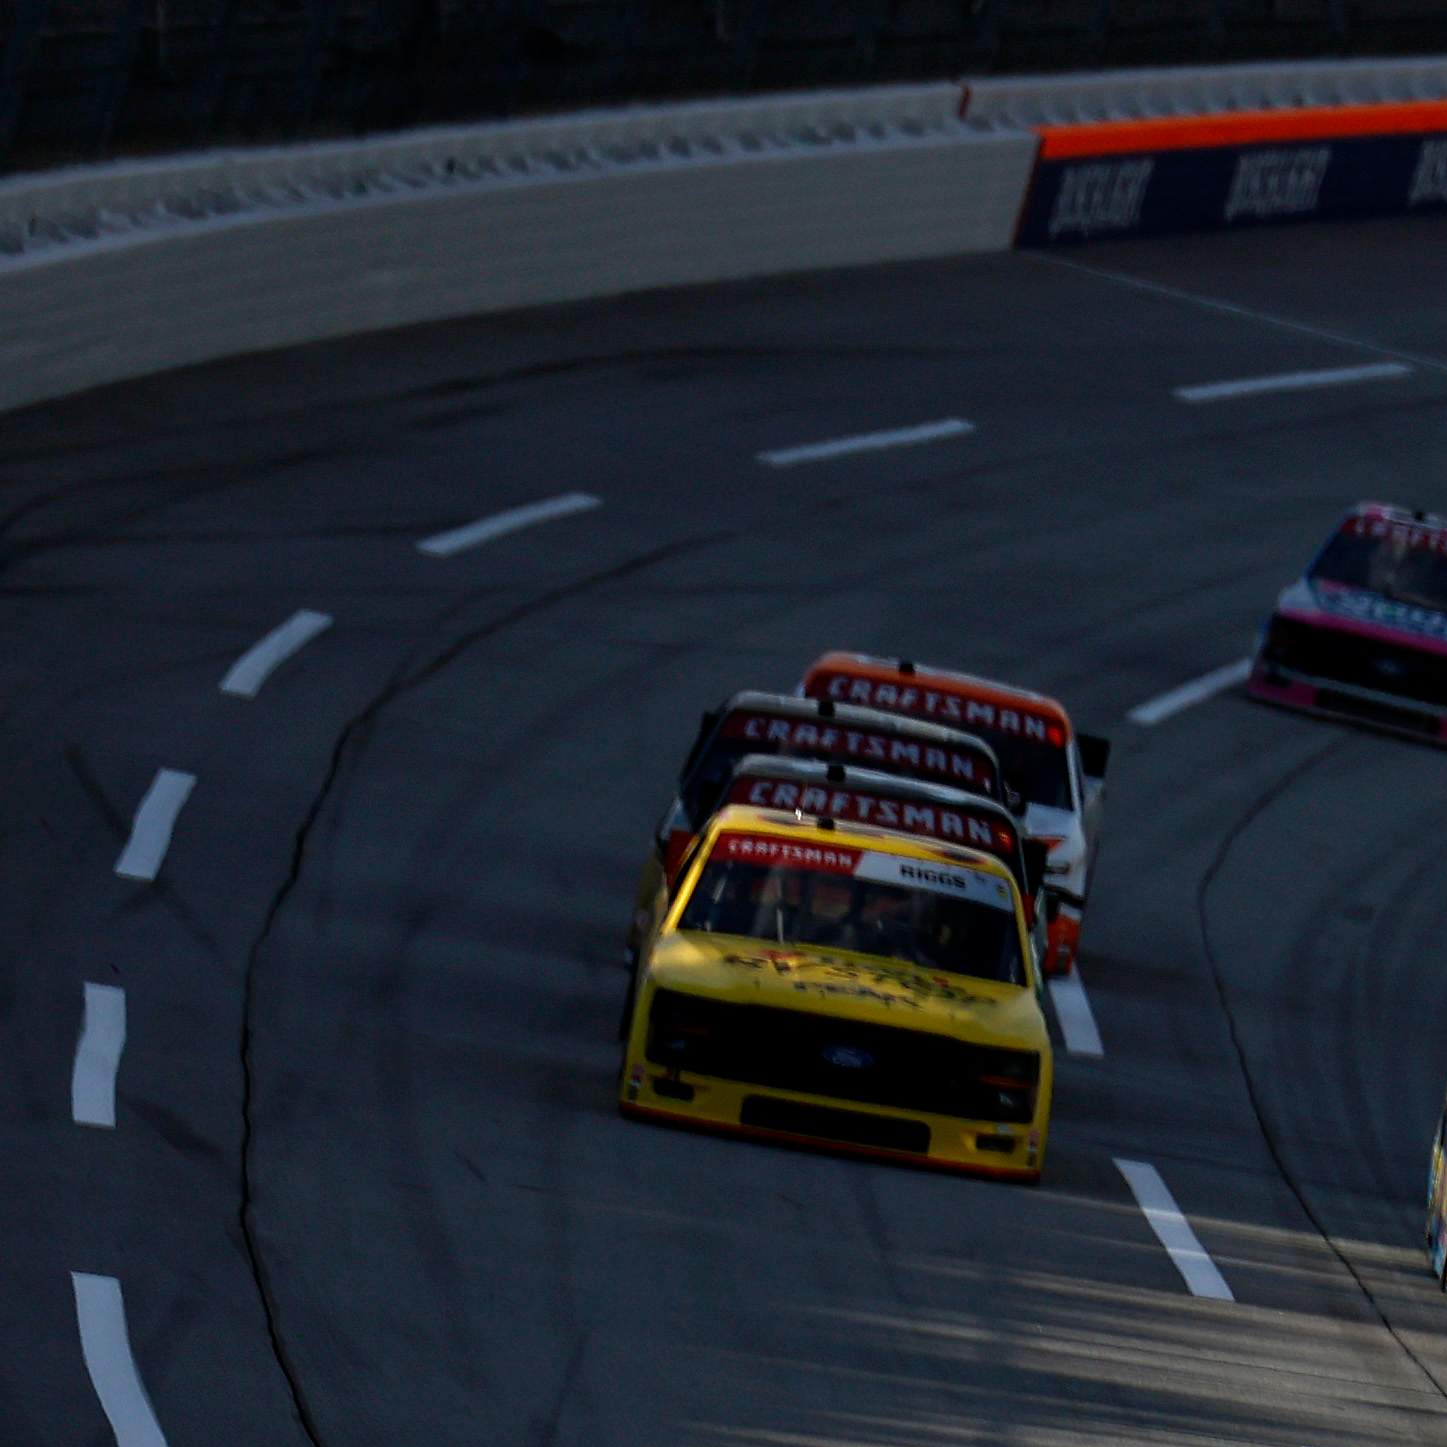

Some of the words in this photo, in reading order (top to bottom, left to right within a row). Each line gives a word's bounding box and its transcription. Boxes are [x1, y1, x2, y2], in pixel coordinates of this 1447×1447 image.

[828, 676, 1047, 742] CRAFTSMAN
[746, 717, 973, 779] CRAFTSMAN
[750, 781, 992, 845] CRAFTSMAN
[729, 838, 852, 868] CRAFTSMAN
[901, 864, 966, 890] RIGGS
